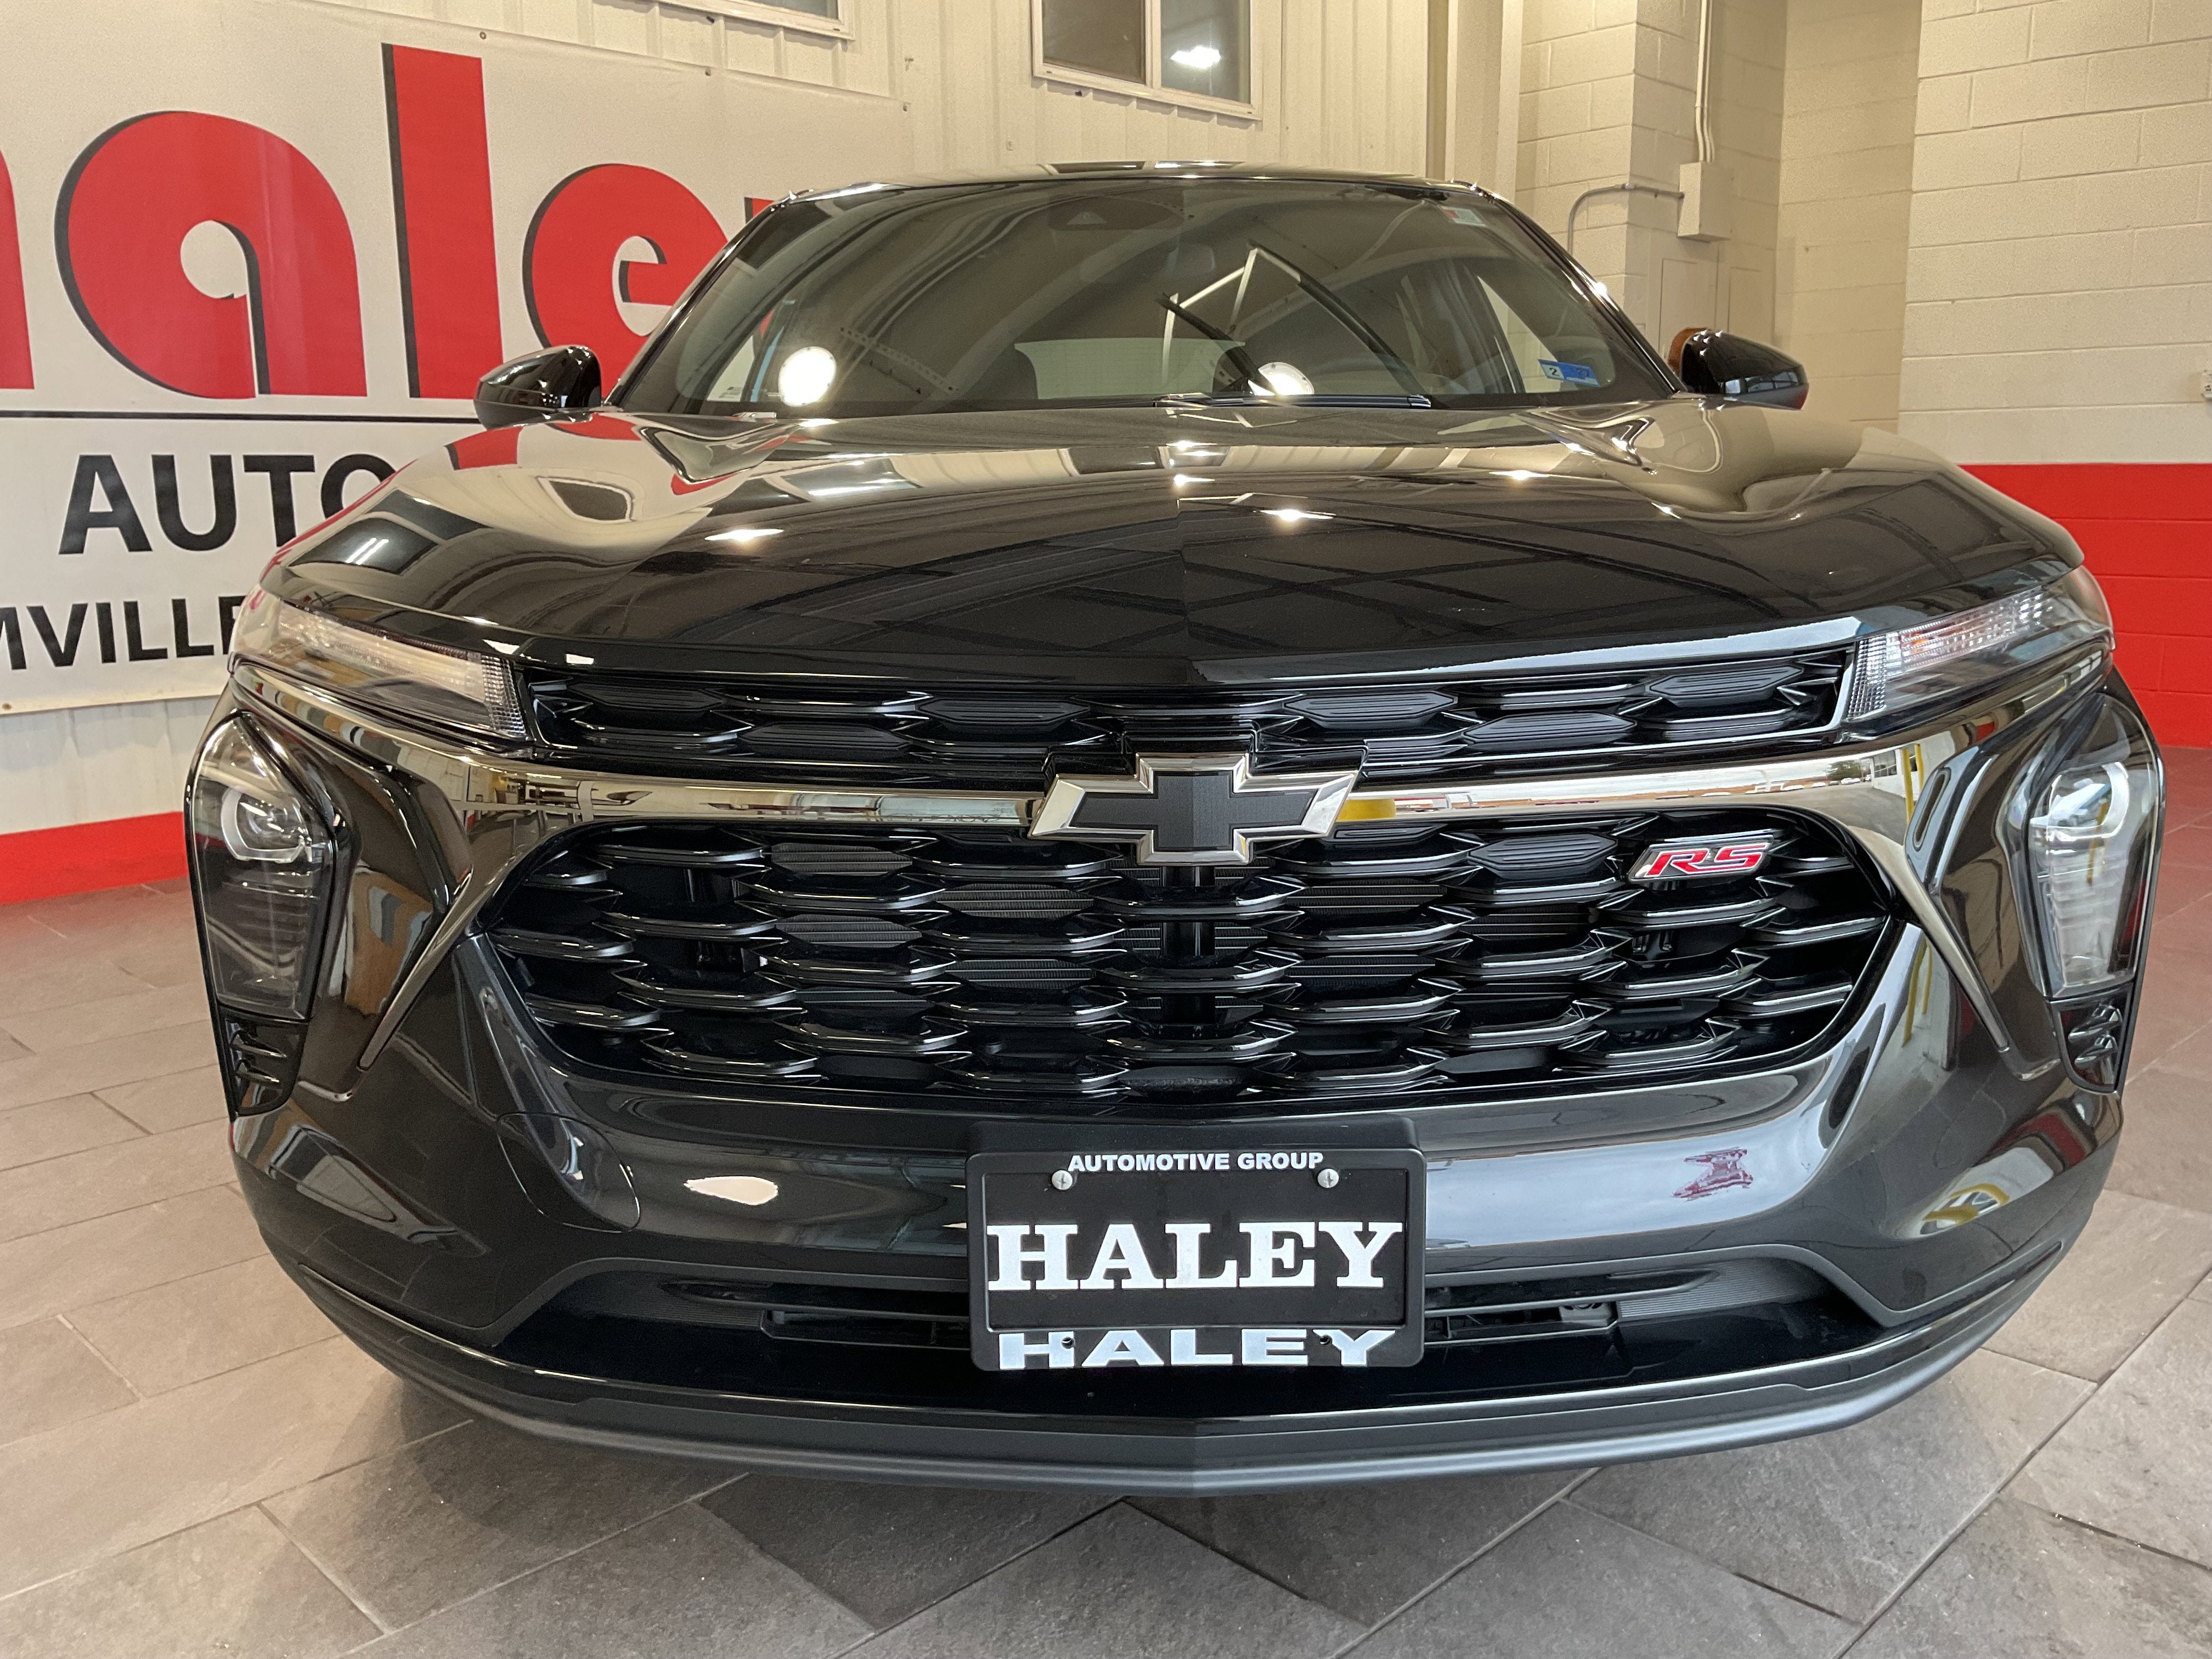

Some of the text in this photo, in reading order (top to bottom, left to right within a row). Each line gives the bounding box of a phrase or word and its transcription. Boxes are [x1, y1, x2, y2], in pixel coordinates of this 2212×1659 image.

[0, 43, 774, 404] ale
[1549, 367, 1560, 376] 2
[1643, 842, 1769, 877] RS
[1067, 1152, 1324, 1172] AUTOMOTIVE GROUP
[986, 1221, 1403, 1291] HALEY
[998, 1328, 1396, 1370] HALEY
